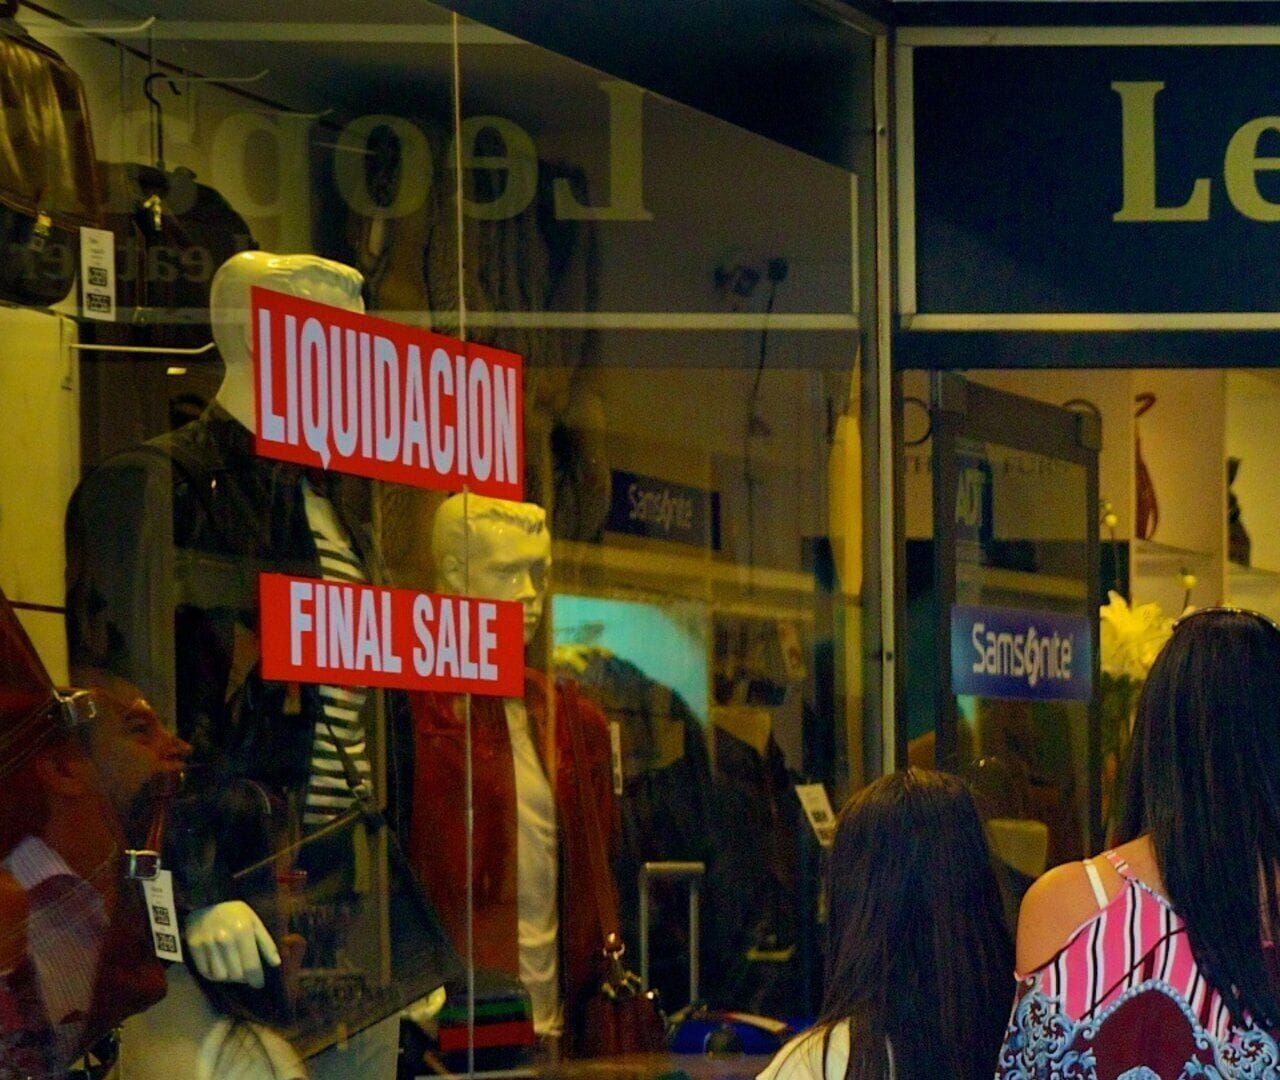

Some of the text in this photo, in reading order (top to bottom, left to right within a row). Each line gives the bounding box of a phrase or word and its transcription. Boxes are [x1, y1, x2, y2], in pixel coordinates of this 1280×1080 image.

[259, 308, 518, 485] LIQUIDACION
[289, 581, 498, 681] FINAL SALE
[971, 622, 1073, 687] Samsonite
